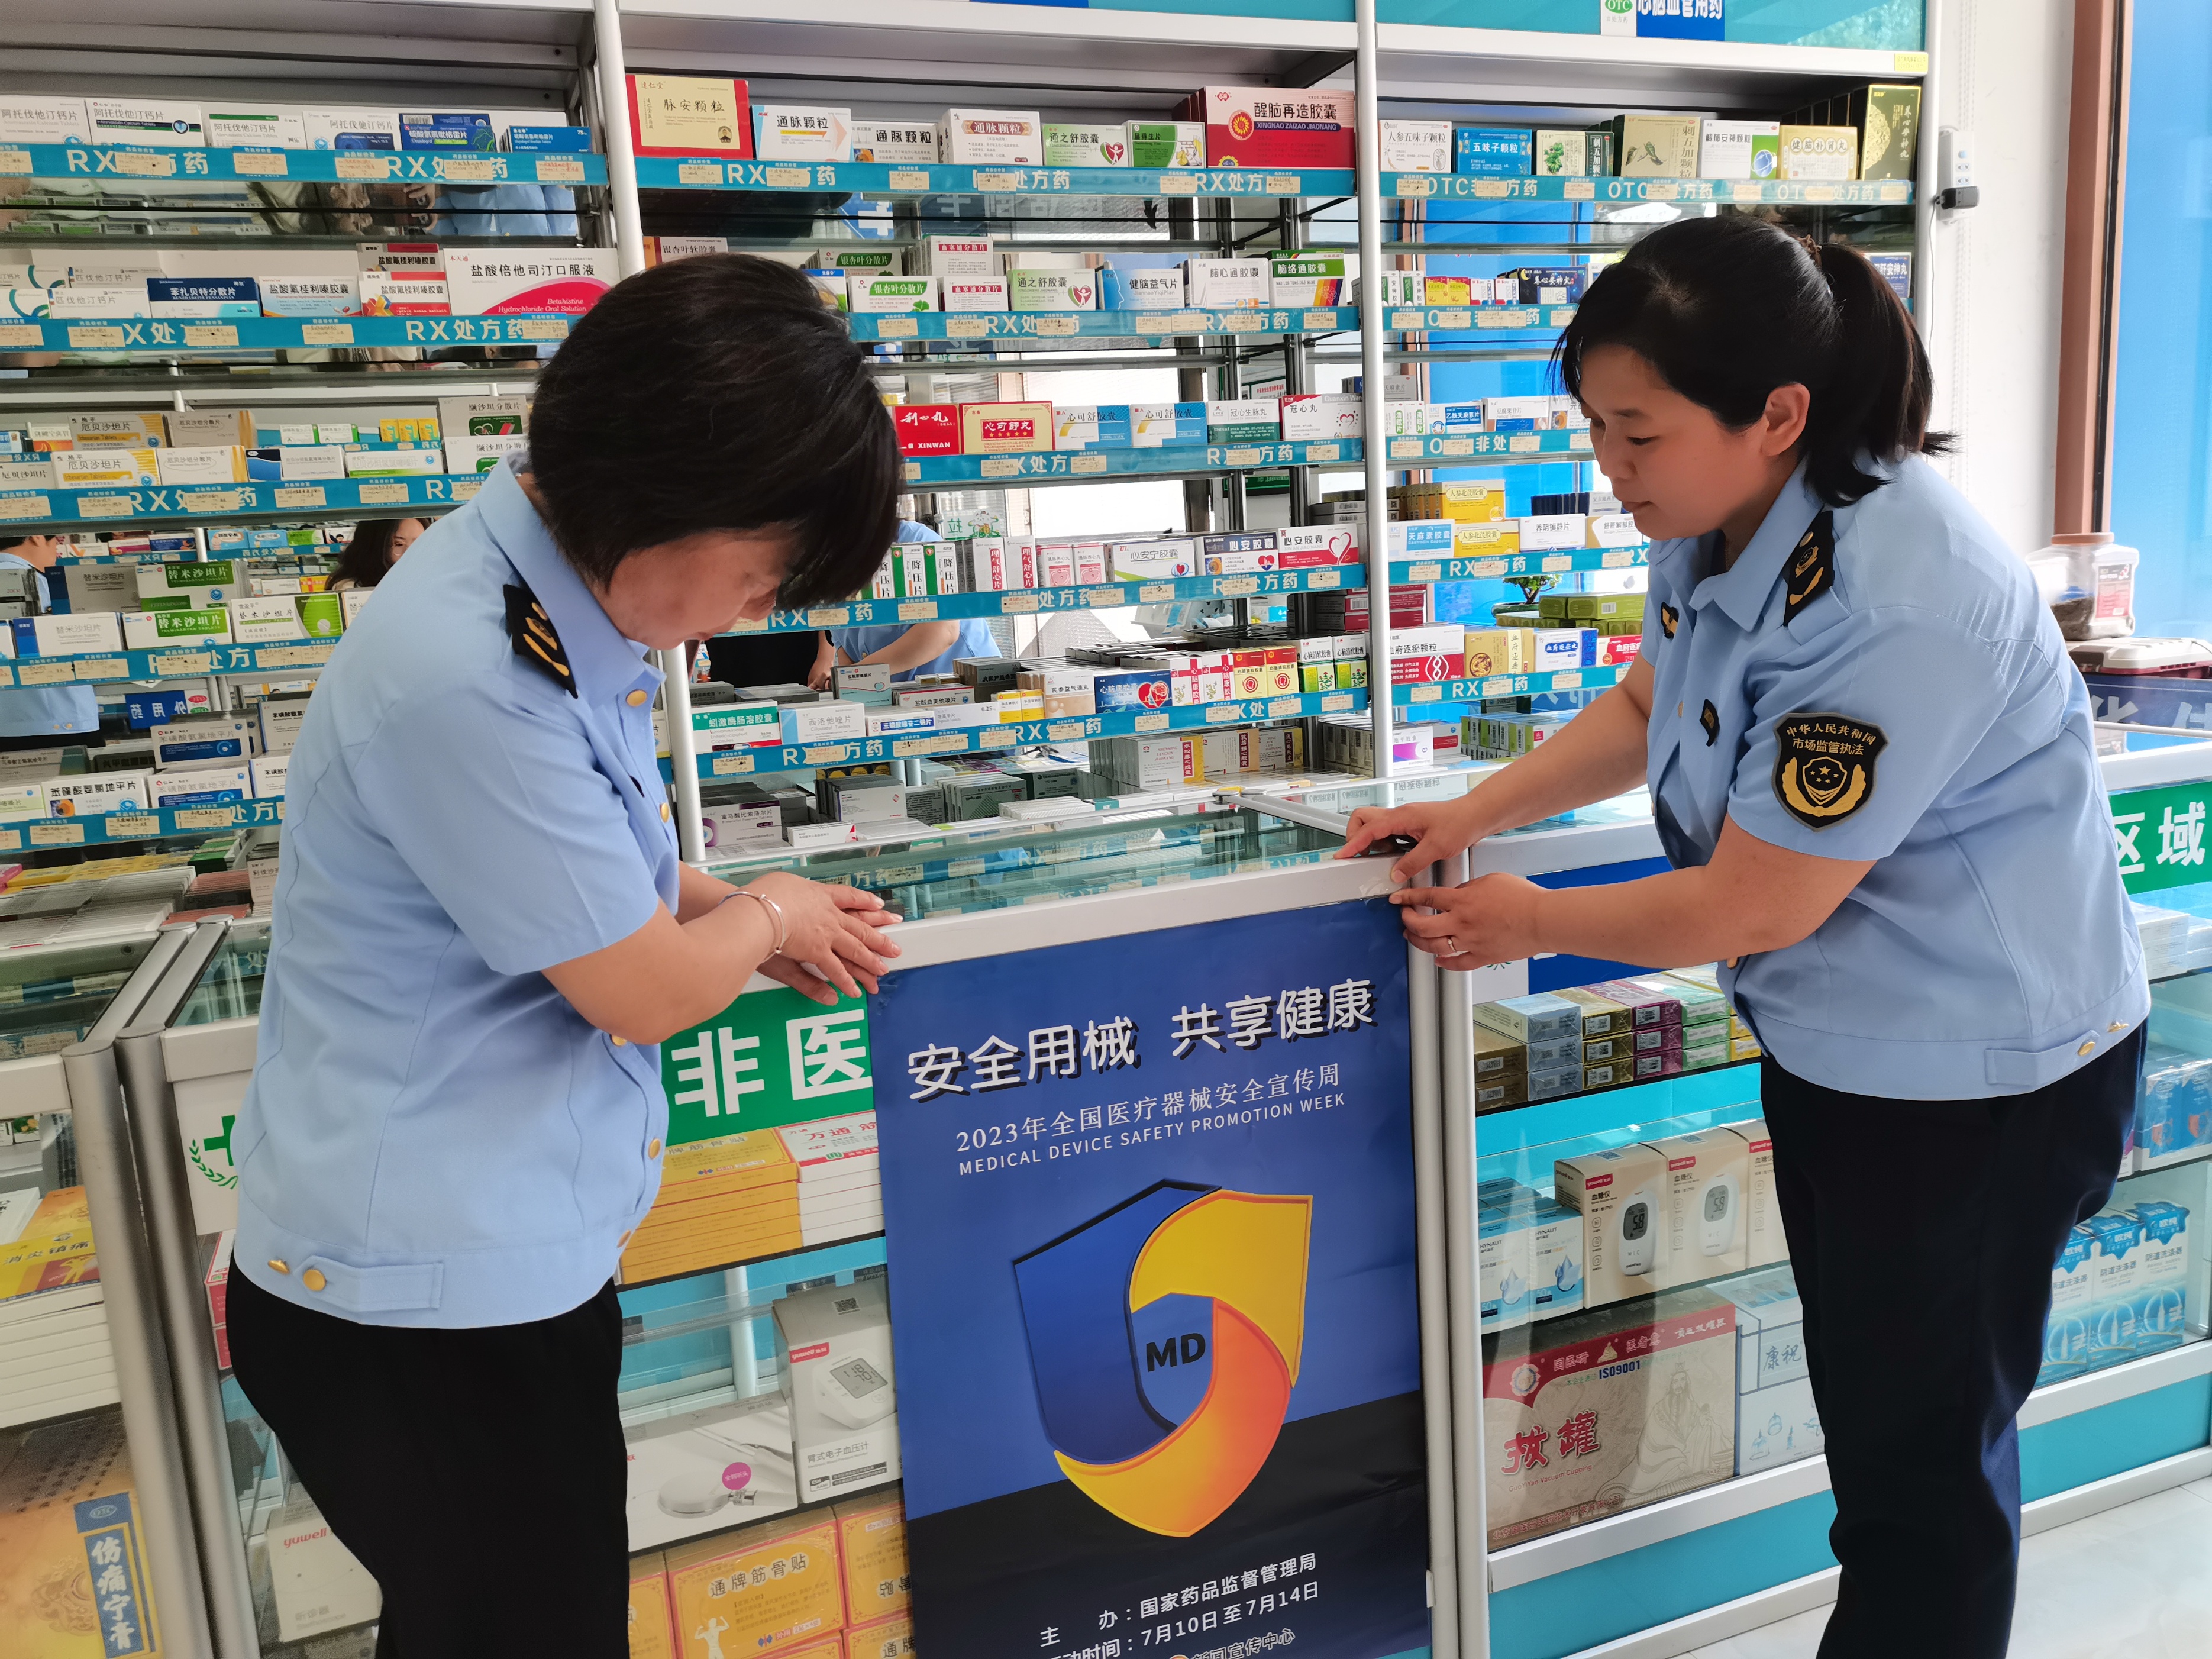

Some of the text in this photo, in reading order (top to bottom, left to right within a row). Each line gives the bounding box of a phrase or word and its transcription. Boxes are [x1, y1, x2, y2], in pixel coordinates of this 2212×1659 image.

[663, 99, 725, 112] 脉安颗粒
[1253, 102, 1337, 121] 醒脑再造胶囊
[1, 108, 77, 121] 阿托伐他汀钙片
[94, 108, 164, 120] 阿托伐他汀钙片
[214, 122, 275, 133] 阿托伐他汀钙片
[330, 120, 393, 131] 阿托伐他汀钙片
[777, 115, 828, 130] 通脉颗粒
[974, 122, 1022, 135] 通脉颗粒
[1257, 122, 1284, 130] XINGNAO
[876, 129, 932, 144] 通脉颗粒
[1049, 132, 1099, 144] 通之舒胶囊
[1387, 132, 1446, 144] 人参五味子颗粒
[1705, 133, 1751, 144] 解郁安神颗粒
[1472, 143, 1519, 154] 五味子颗粒
[1791, 138, 1848, 151] 健脑补肾丸
[1679, 126, 1696, 177] 刺五加颗粒
[67, 149, 208, 175] RX药
[387, 157, 508, 178] RX处药
[728, 163, 835, 186] RX药
[379, 256, 436, 266] 盐酸氟桂利嗪胶囊
[840, 254, 889, 266] 银杏叶分散片
[471, 264, 596, 278] 盐酸倍他司汀口服液
[1210, 267, 1260, 279] 脑心通胶囊
[1277, 263, 1327, 275] 脑络通胶囊
[75, 274, 133, 283] 匹伐他汀钙片
[1018, 277, 1067, 289] 通之舒胶囊
[1129, 278, 1178, 289] 健脑益气片
[170, 288, 236, 296] 苯扎贝特分散片
[269, 283, 349, 295] 盐酸氟桂利嗪胶囊
[380, 285, 444, 295] 盐酸氟桂利嗪胶囊
[874, 282, 924, 295] 银杏叶分散片
[954, 285, 1002, 293] 血塞通分散片
[55, 296, 116, 305] 匹伐他汀钙片
[1145, 408, 1193, 419] 心可舒胶囊
[1230, 408, 1267, 417] 冠心生脉丸
[1290, 404, 1317, 413] 冠心丸
[900, 411, 948, 425] 利心丸
[1067, 411, 1116, 422] 心可舒胶囊
[82, 422, 131, 431] 厄贝沙坦片
[984, 421, 1032, 432] 心可舒丸
[68, 460, 121, 470] 厄贝沙坦片
[1450, 487, 1485, 498] 人参北芪胶囊
[1536, 522, 1571, 532] 养阴镇静片
[1284, 535, 1323, 546] 心安胶囊
[1408, 531, 1451, 540] 天麻素胶囊
[1461, 530, 1498, 540] 人参北芪胶囊
[1229, 537, 1274, 551] 心安胶囊
[1130, 548, 1178, 559] 心安宁胶囊
[990, 549, 1002, 589] 理气舒心片
[1022, 547, 1033, 588] 理气舒心片
[1449, 557, 1526, 576] RX药
[83, 573, 125, 581] 替米沙坦片
[168, 567, 228, 579] 替米沙坦片
[912, 560, 923, 596] 降压片
[944, 559, 955, 594] 降压片
[239, 609, 293, 619] 替米沙坦片
[771, 603, 873, 627] RX药
[158, 616, 222, 628] 替米沙坦片
[56, 624, 101, 633] 替米沙坦片
[1336, 645, 1364, 657] 心脑清软胶囊
[1546, 643, 1578, 651] 血府逐瘀丸
[1303, 648, 1332, 661] 心脑清软胶囊
[1051, 685, 1089, 695] 芪参益气滴丸
[1099, 682, 1138, 693] 心脑康胶囊
[1453, 677, 1528, 696] RX药
[709, 713, 773, 728] 蚓激酶肠溶胶囊
[808, 714, 851, 725] 西洛他唑片
[159, 730, 235, 743] 苯磺酸氨氯地平片
[1787, 722, 1877, 745] 中华人民共和国
[1793, 737, 1864, 756] 市场监管执法
[51, 782, 136, 797] 苯磺酸氨氯地平片
[157, 780, 237, 793] 苯磺酸氨氯地平片
[721, 808, 773, 821] 富马酸比索洛尔片
[2113, 801, 2205, 876] 区域
[908, 977, 1376, 1101] 安全用械 共享健康
[671, 1009, 873, 1118] 非医
[956, 1062, 1340, 1153] 2023年全国医疗器械安全宣传周
[959, 1091, 1346, 1176] MEDICAL DEVICE SAFETY PROMOTION WEEK
[1674, 1173, 1693, 1182] 血糖仪
[1591, 1190, 1610, 1201] 血糖仪
[792, 1349, 815, 1359] yuwell
[1146, 1332, 1206, 1373] MD
[1763, 1343, 1802, 1372] 康祝
[1599, 1360, 1641, 1380] ISO9001
[1501, 1409, 1601, 1475] 拔罐
[808, 1441, 869, 1463] 臂式电子血压计
[1540, 1470, 1565, 1483] Vacuum
[1566, 1464, 1593, 1478] Cupping
[283, 1528, 327, 1548] yuwell
[710, 1554, 806, 1598] 通牌筋骨贴
[91, 1537, 135, 1650] 伤痛宁膏
[1040, 1626, 1060, 1647] 主
